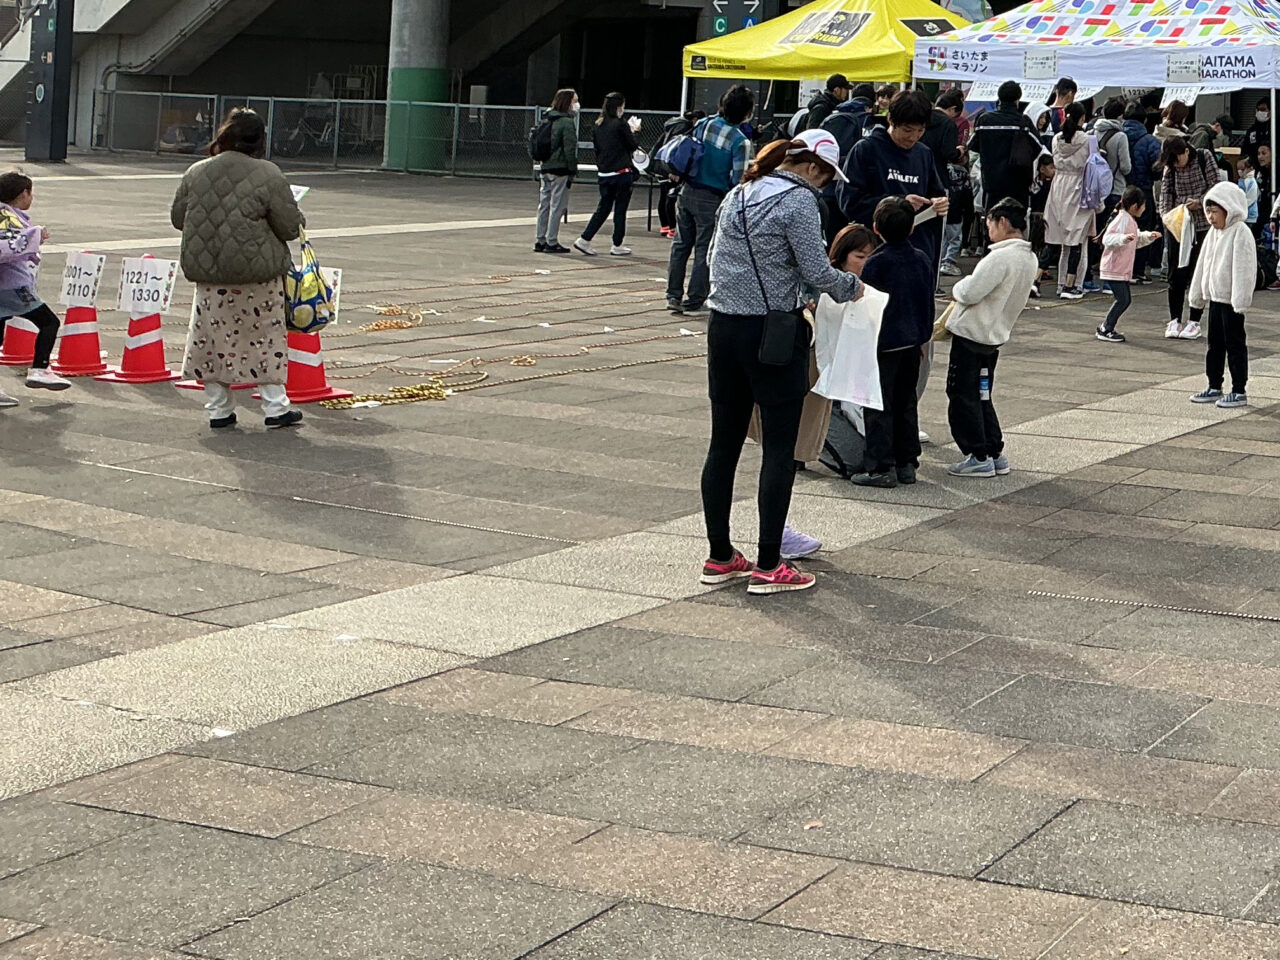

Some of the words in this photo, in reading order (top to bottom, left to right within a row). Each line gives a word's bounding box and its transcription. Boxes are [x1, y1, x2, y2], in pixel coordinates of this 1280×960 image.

[716, 18, 726, 33] C
[951, 50, 989, 60] さいたま
[951, 62, 988, 73] マラソン
[66, 282, 90, 298] 2110
[131, 288, 161, 303] 1330
